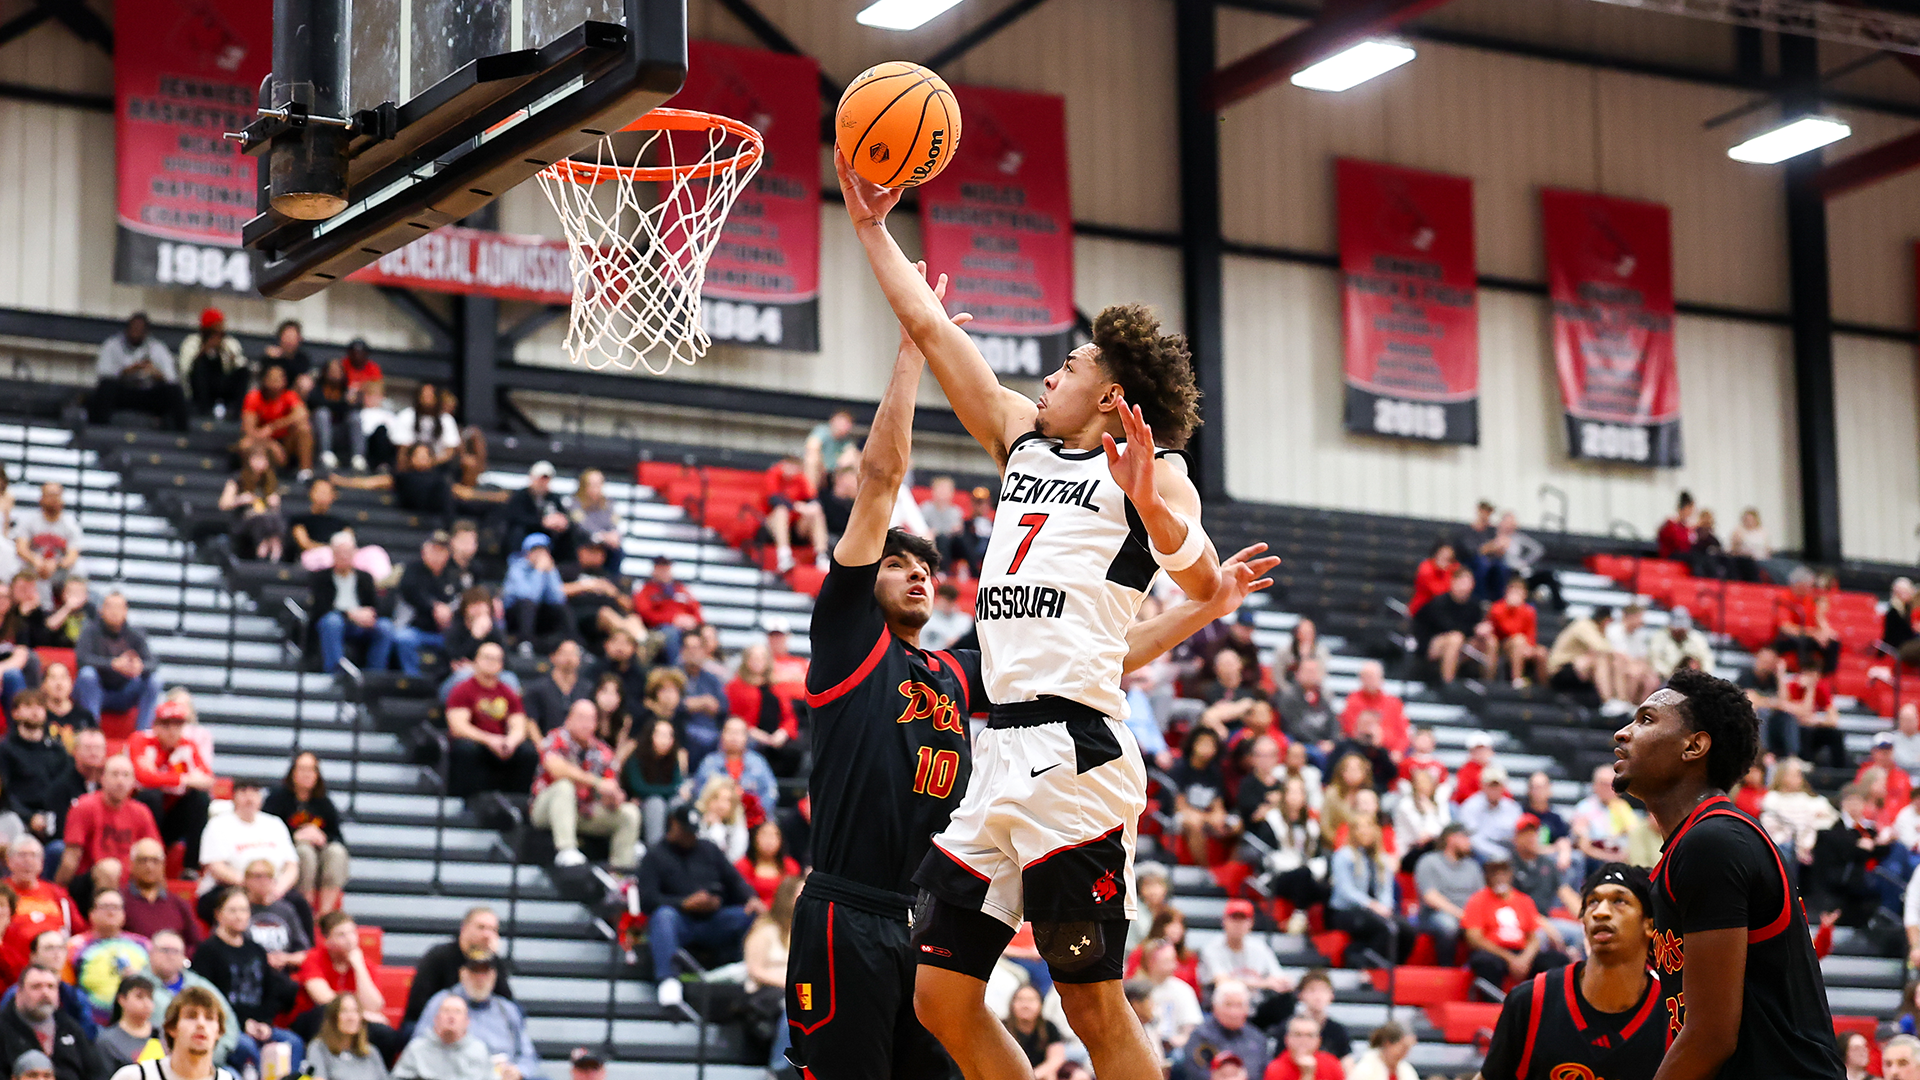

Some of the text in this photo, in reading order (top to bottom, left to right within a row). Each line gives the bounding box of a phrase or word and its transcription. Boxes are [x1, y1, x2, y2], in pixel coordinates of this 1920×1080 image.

[156, 242, 251, 292] 1984
[1001, 472, 1100, 513] CENTRAL
[1006, 512, 1050, 575] 7
[913, 745, 960, 799] 10
